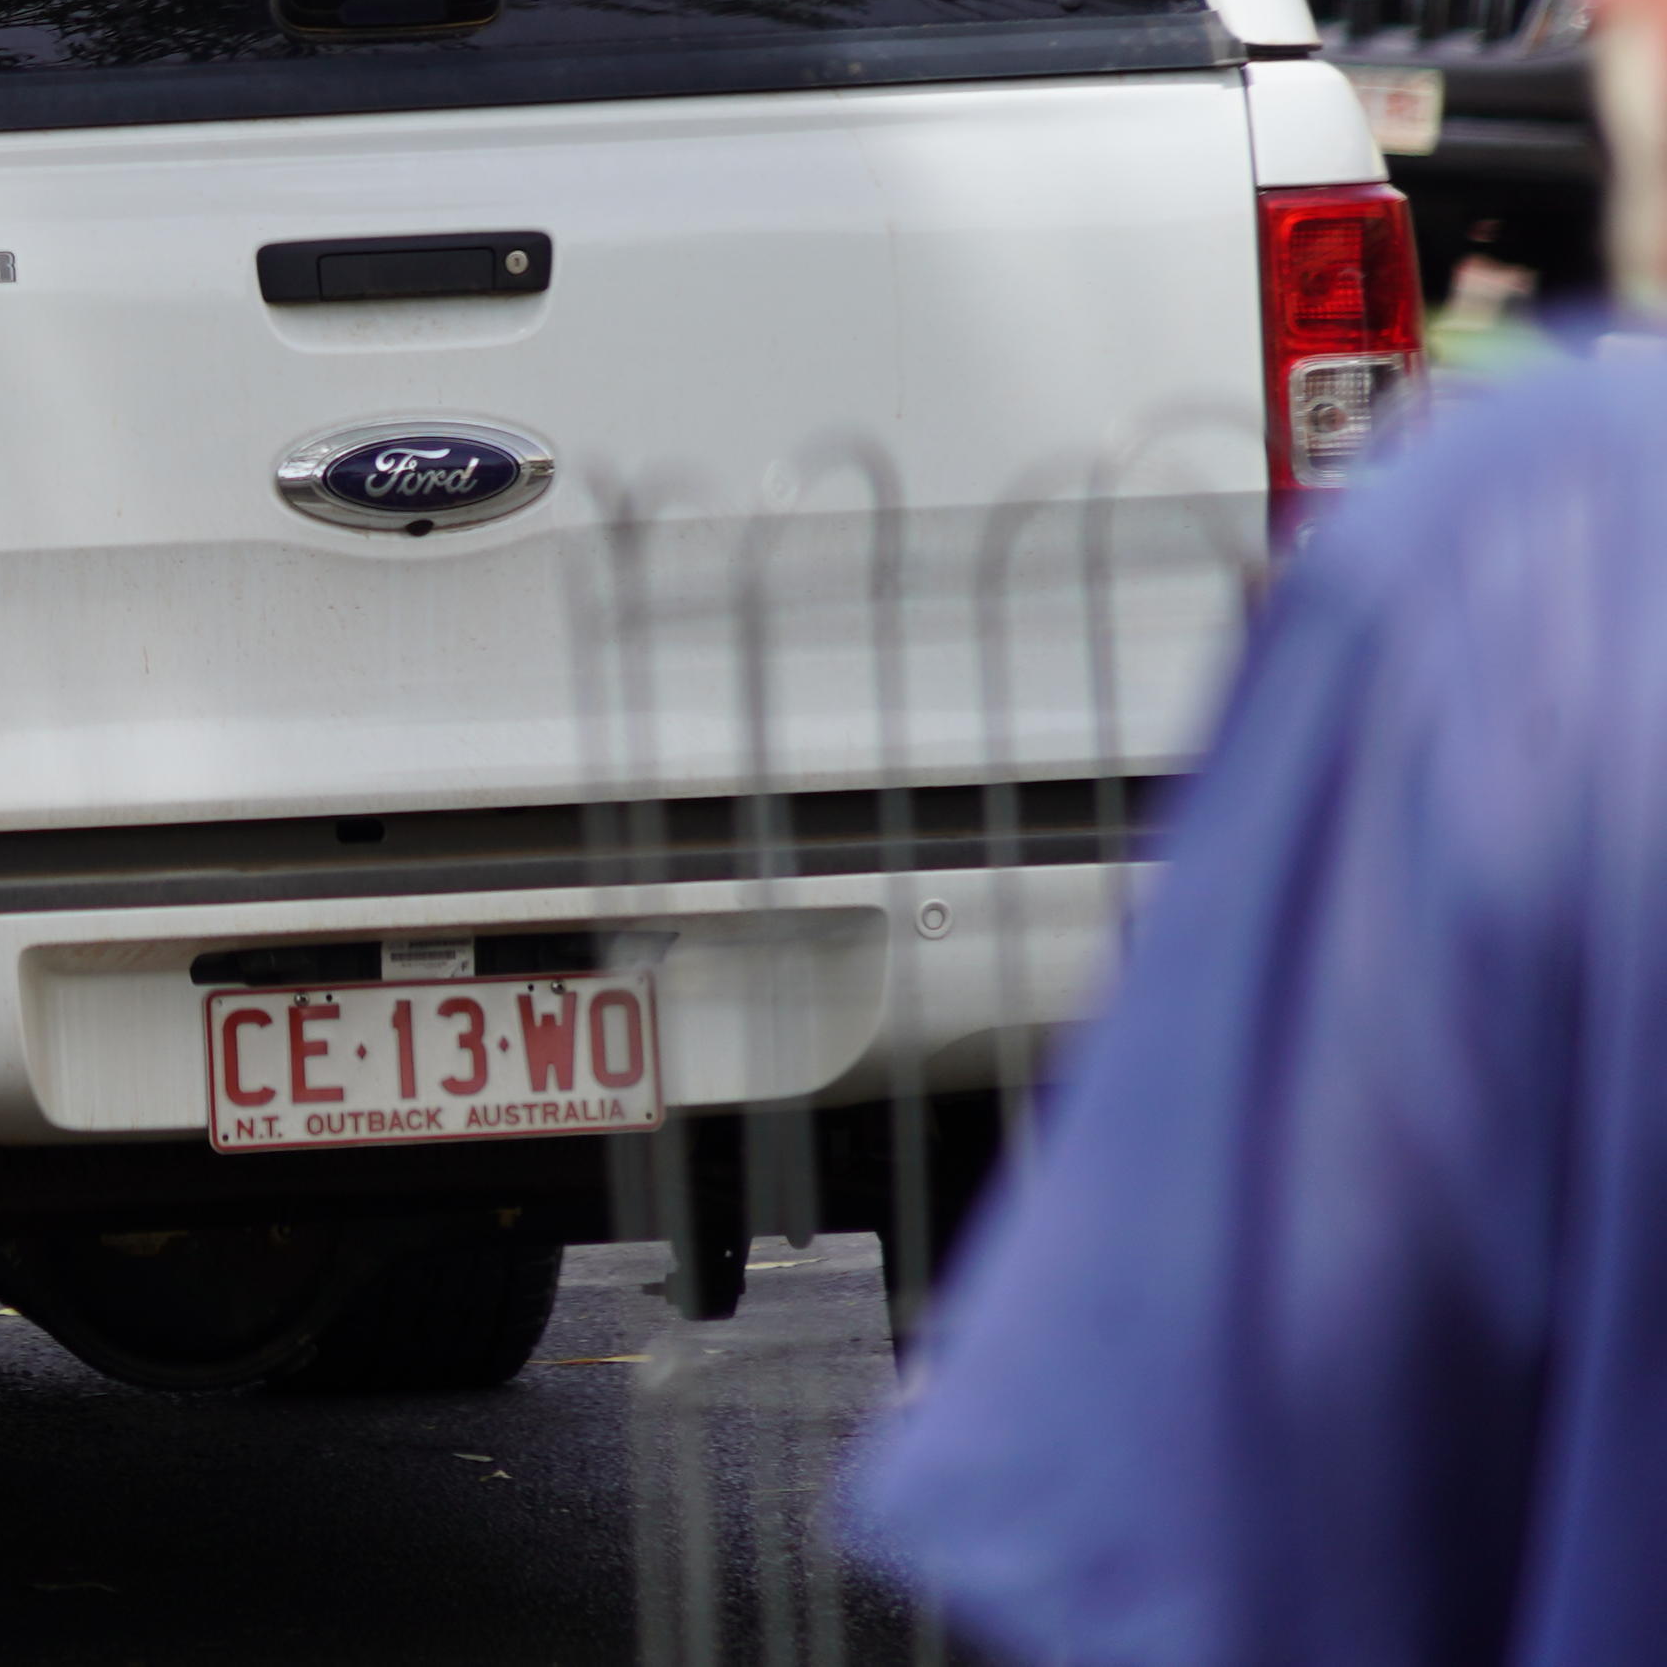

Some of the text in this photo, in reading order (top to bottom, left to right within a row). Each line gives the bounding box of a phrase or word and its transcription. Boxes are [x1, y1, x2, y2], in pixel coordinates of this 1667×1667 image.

[364, 447, 480, 499] Ford
[236, 1098, 627, 1140] N.T. OUTBACK AUSTRALIA
